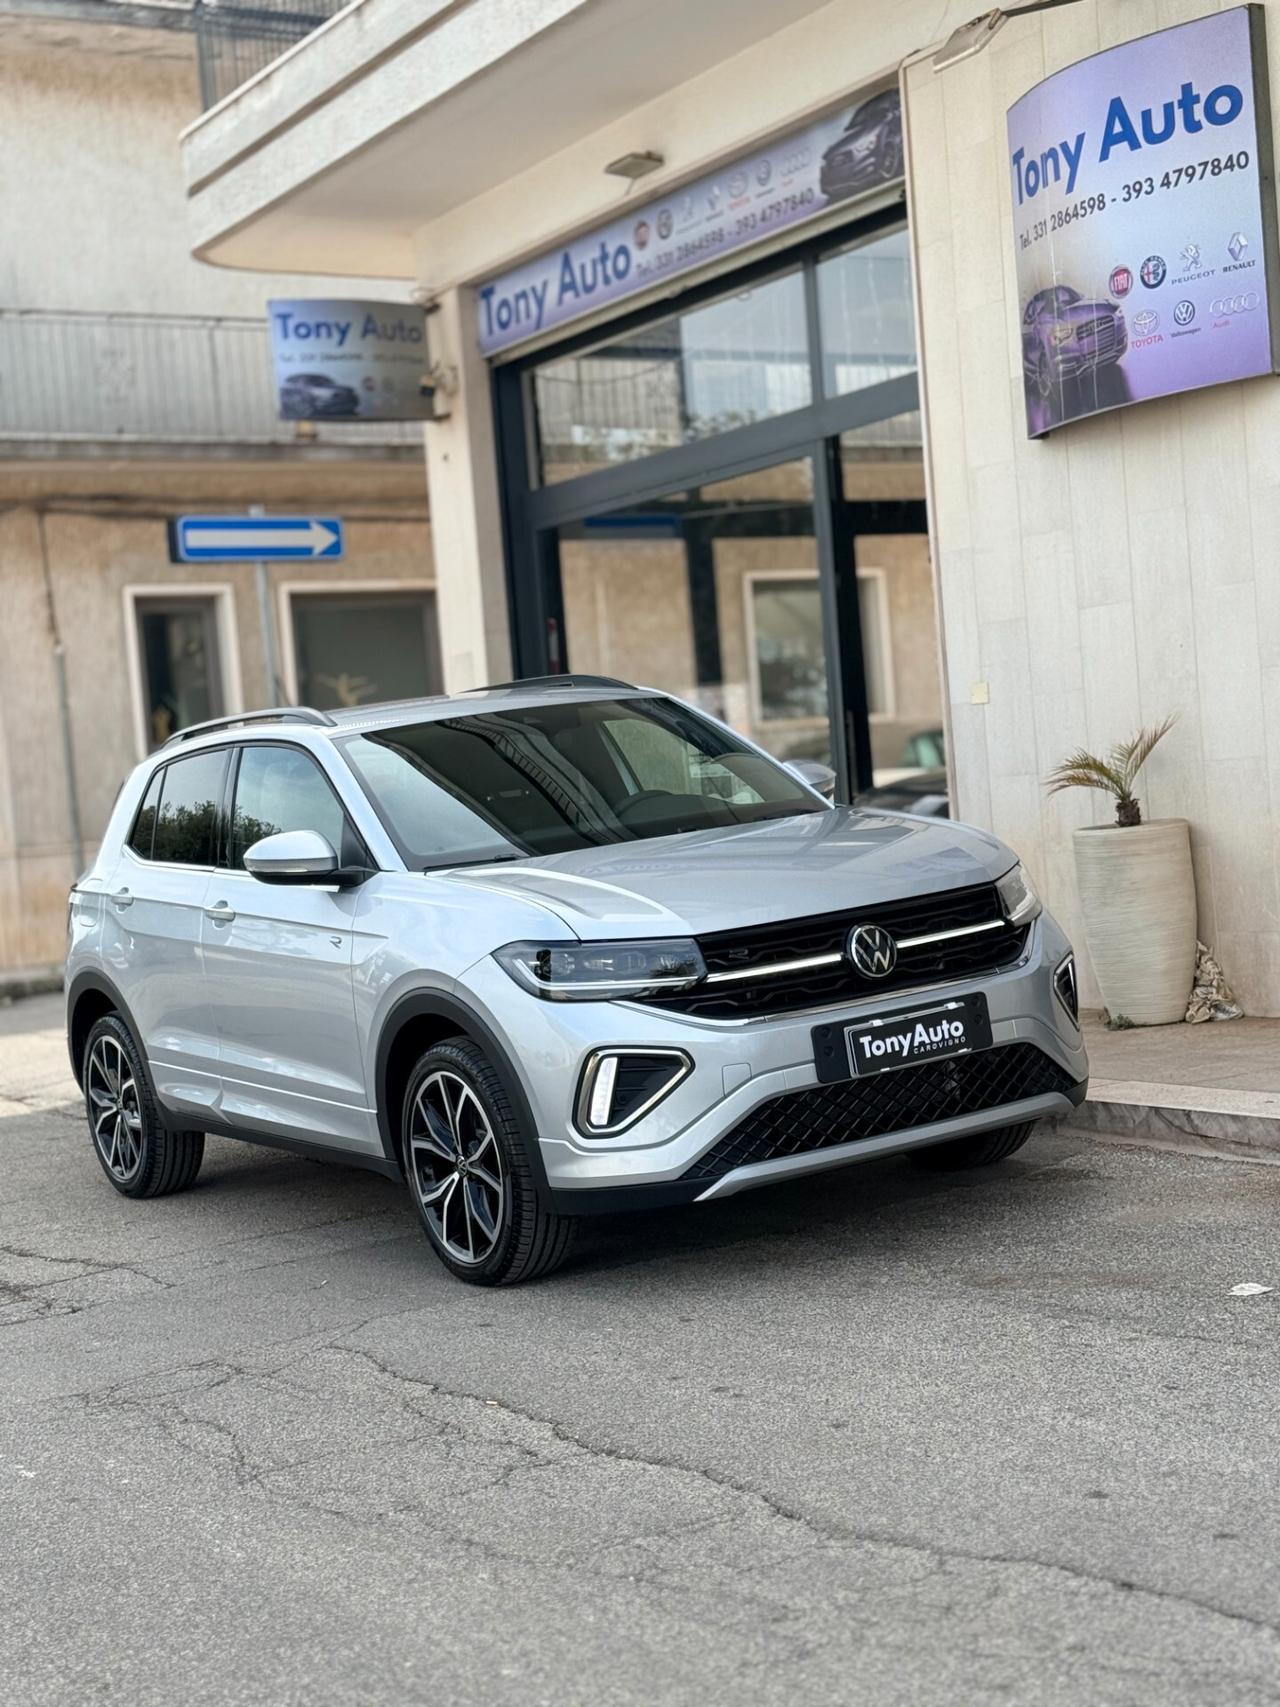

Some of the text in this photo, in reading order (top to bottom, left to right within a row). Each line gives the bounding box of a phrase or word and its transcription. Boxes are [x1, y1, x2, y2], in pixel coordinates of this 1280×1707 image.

[1012, 81, 1244, 205] Tony Auto
[1019, 229, 1032, 251] Tel.
[1033, 219, 1048, 241] 331
[1050, 193, 1106, 232] 2864598
[1122, 177, 1154, 203] 393
[1160, 150, 1250, 190] 4797840
[1171, 269, 1216, 285] PEUGEOT
[1222, 259, 1256, 273] RENAULT
[479, 241, 631, 337] Tony Auto
[275, 312, 423, 346] Tony Auto
[1131, 334, 1163, 349] TOYOTA
[859, 1019, 964, 1058] TonyAuto
[913, 1037, 967, 1055] CAROVIGNO
